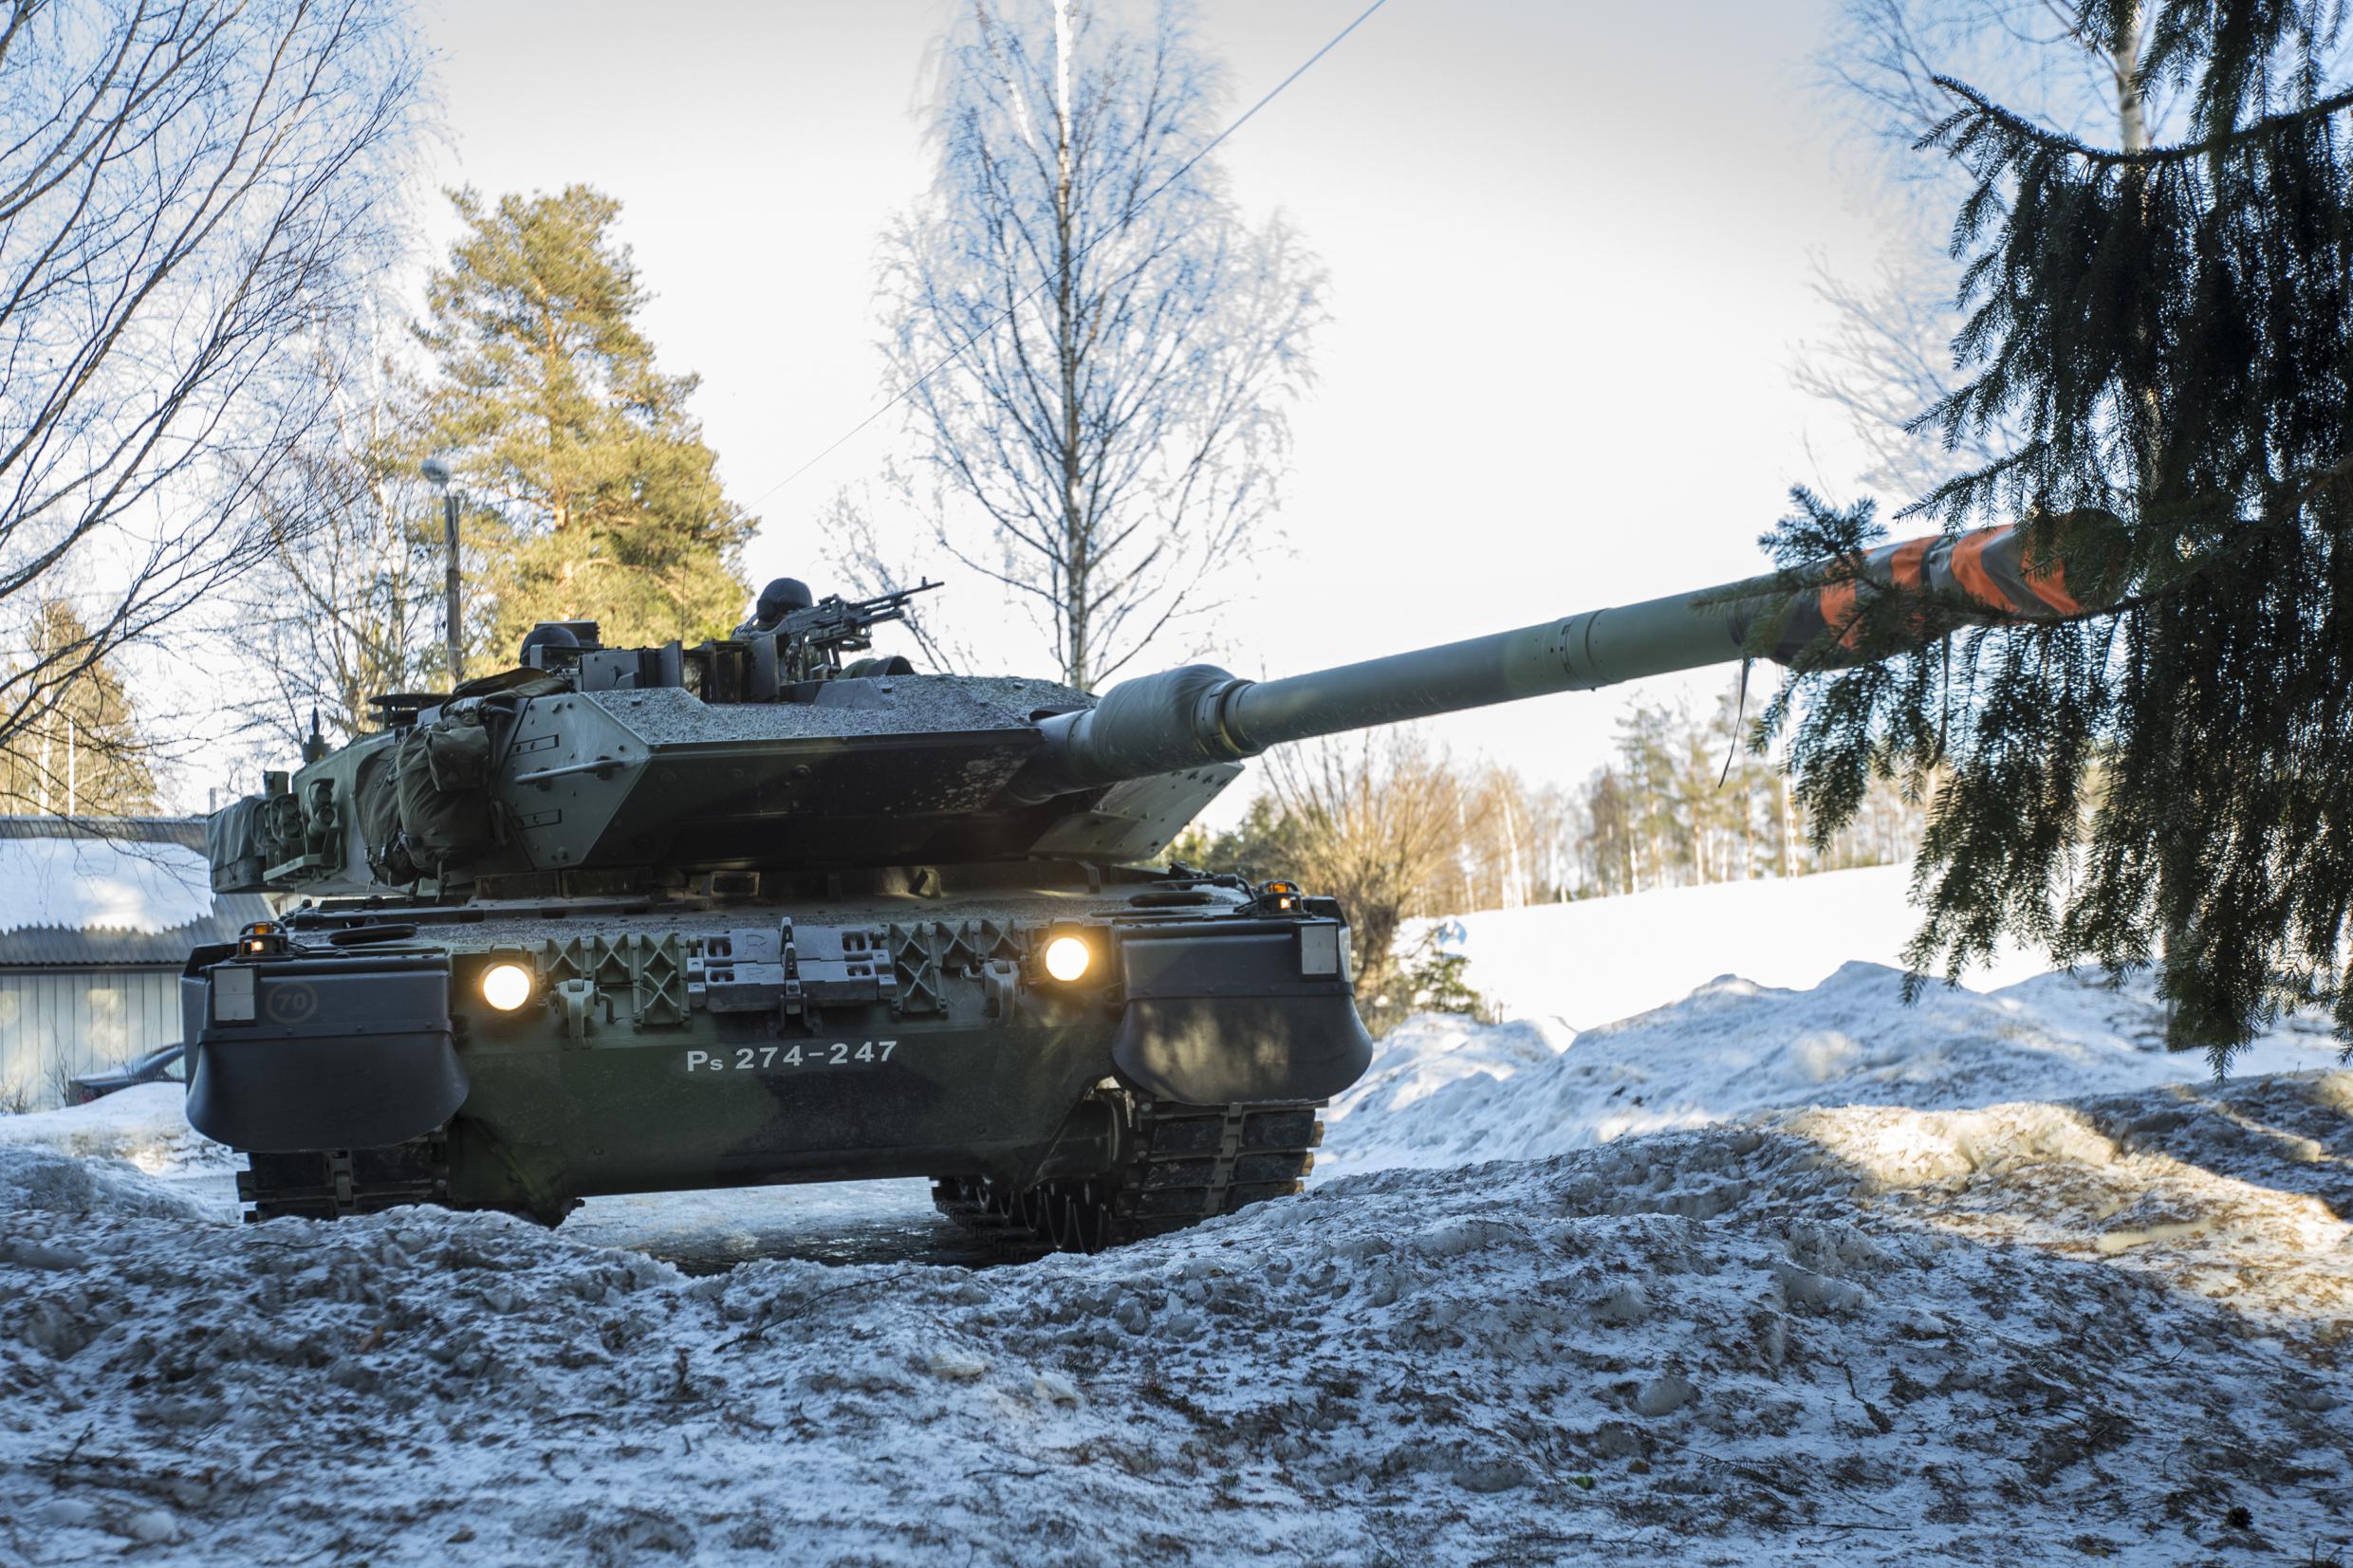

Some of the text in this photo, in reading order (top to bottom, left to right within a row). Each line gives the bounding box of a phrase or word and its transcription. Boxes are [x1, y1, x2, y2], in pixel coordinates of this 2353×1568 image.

[276, 992, 307, 1011] 70
[686, 1041, 899, 1073] Ps 274-247
